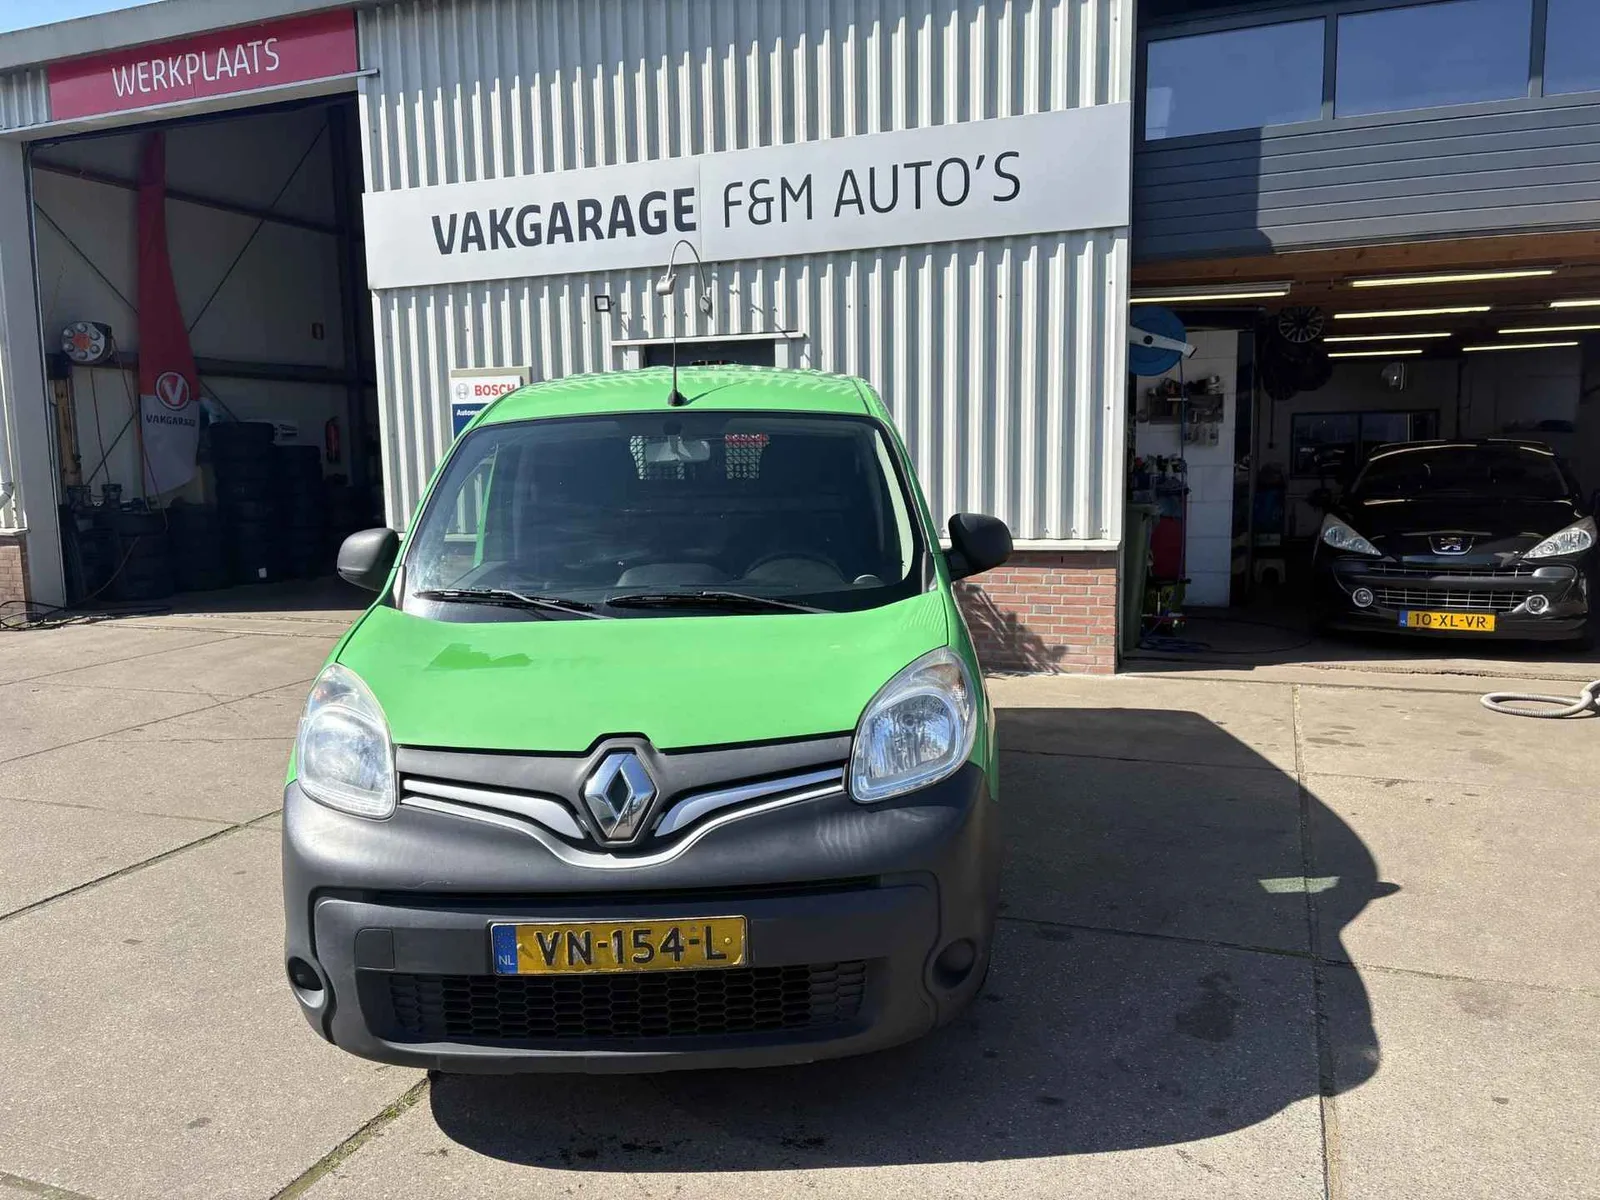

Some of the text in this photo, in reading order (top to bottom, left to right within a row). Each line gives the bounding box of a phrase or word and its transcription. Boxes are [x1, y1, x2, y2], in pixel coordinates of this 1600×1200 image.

[111, 37, 280, 97] WERKPLAATS
[431, 151, 1021, 255] VAKGARAGE F&M AUTO'S
[1415, 613, 1486, 628] 10-XL-VR
[498, 954, 515, 966] NL
[535, 926, 727, 966] VN-154-L
